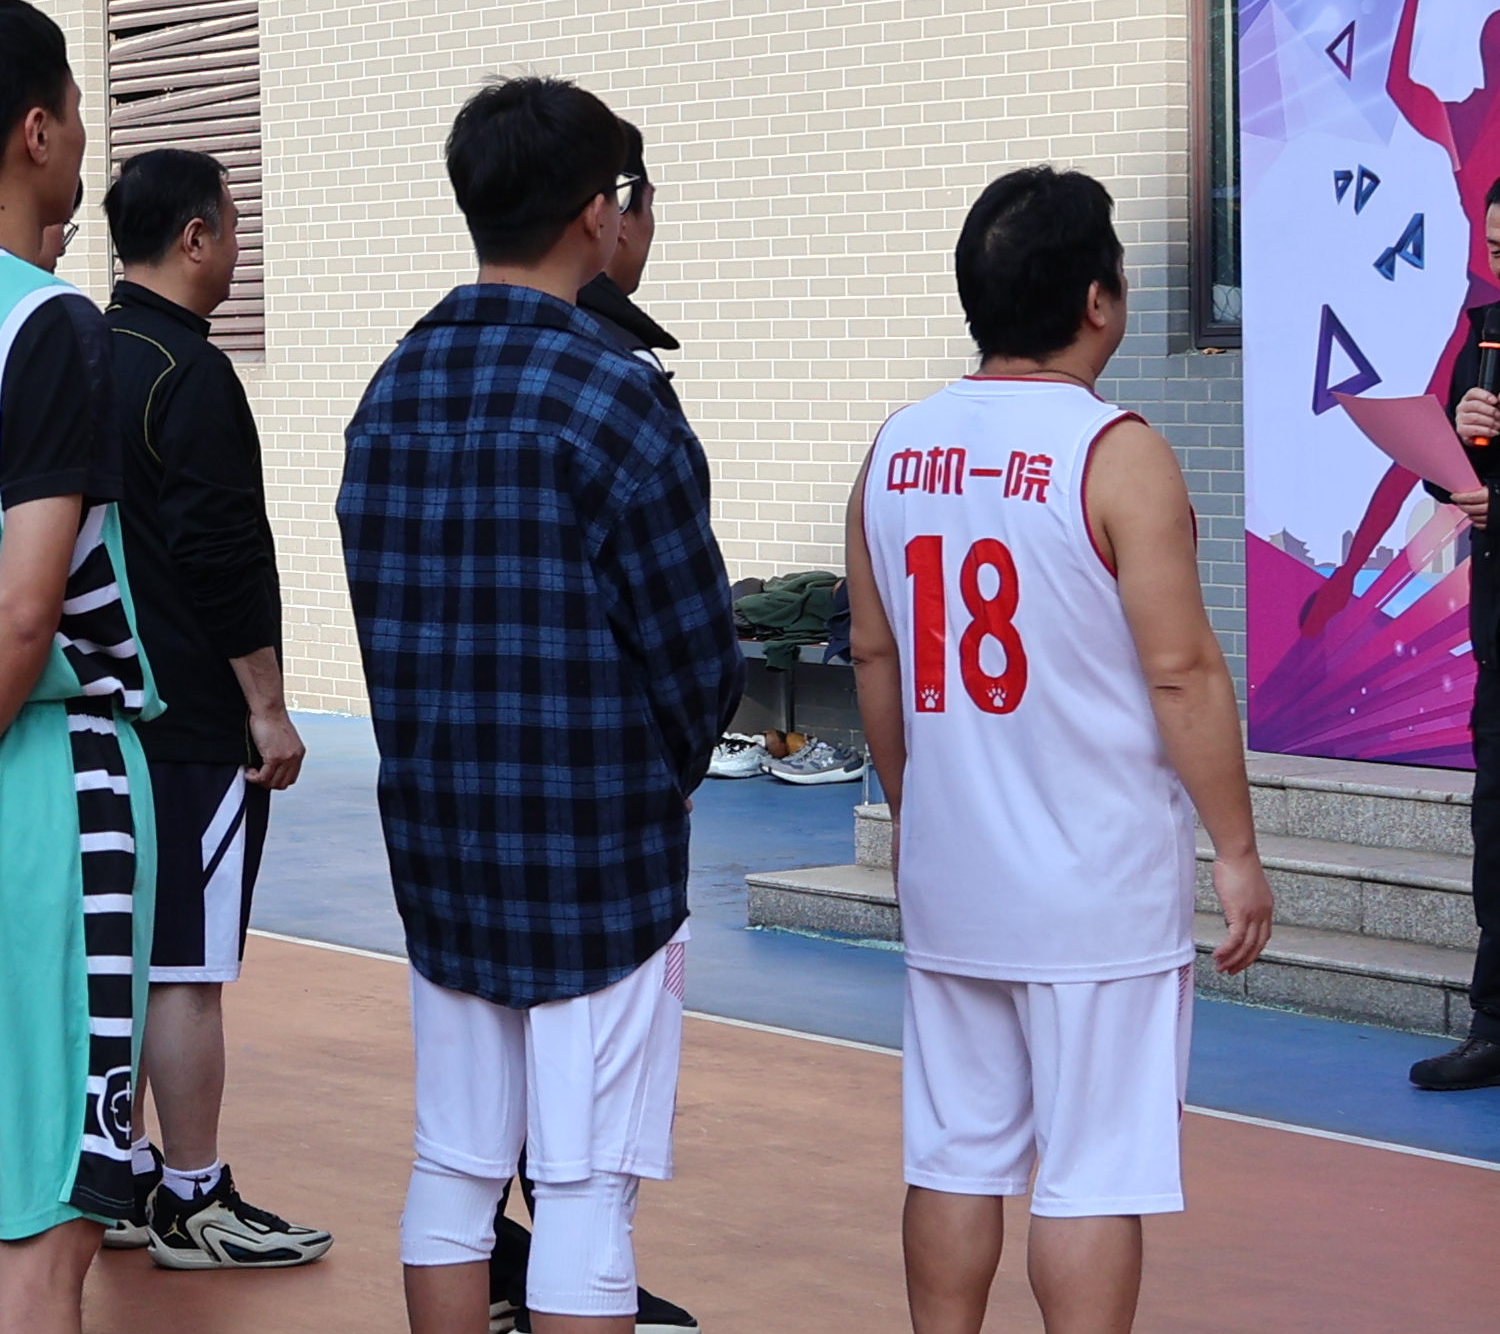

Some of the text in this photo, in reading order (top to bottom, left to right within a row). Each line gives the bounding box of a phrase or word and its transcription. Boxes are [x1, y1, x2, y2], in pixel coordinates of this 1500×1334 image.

[886, 446, 1055, 504] 中机一院
[904, 534, 1028, 715] 18
